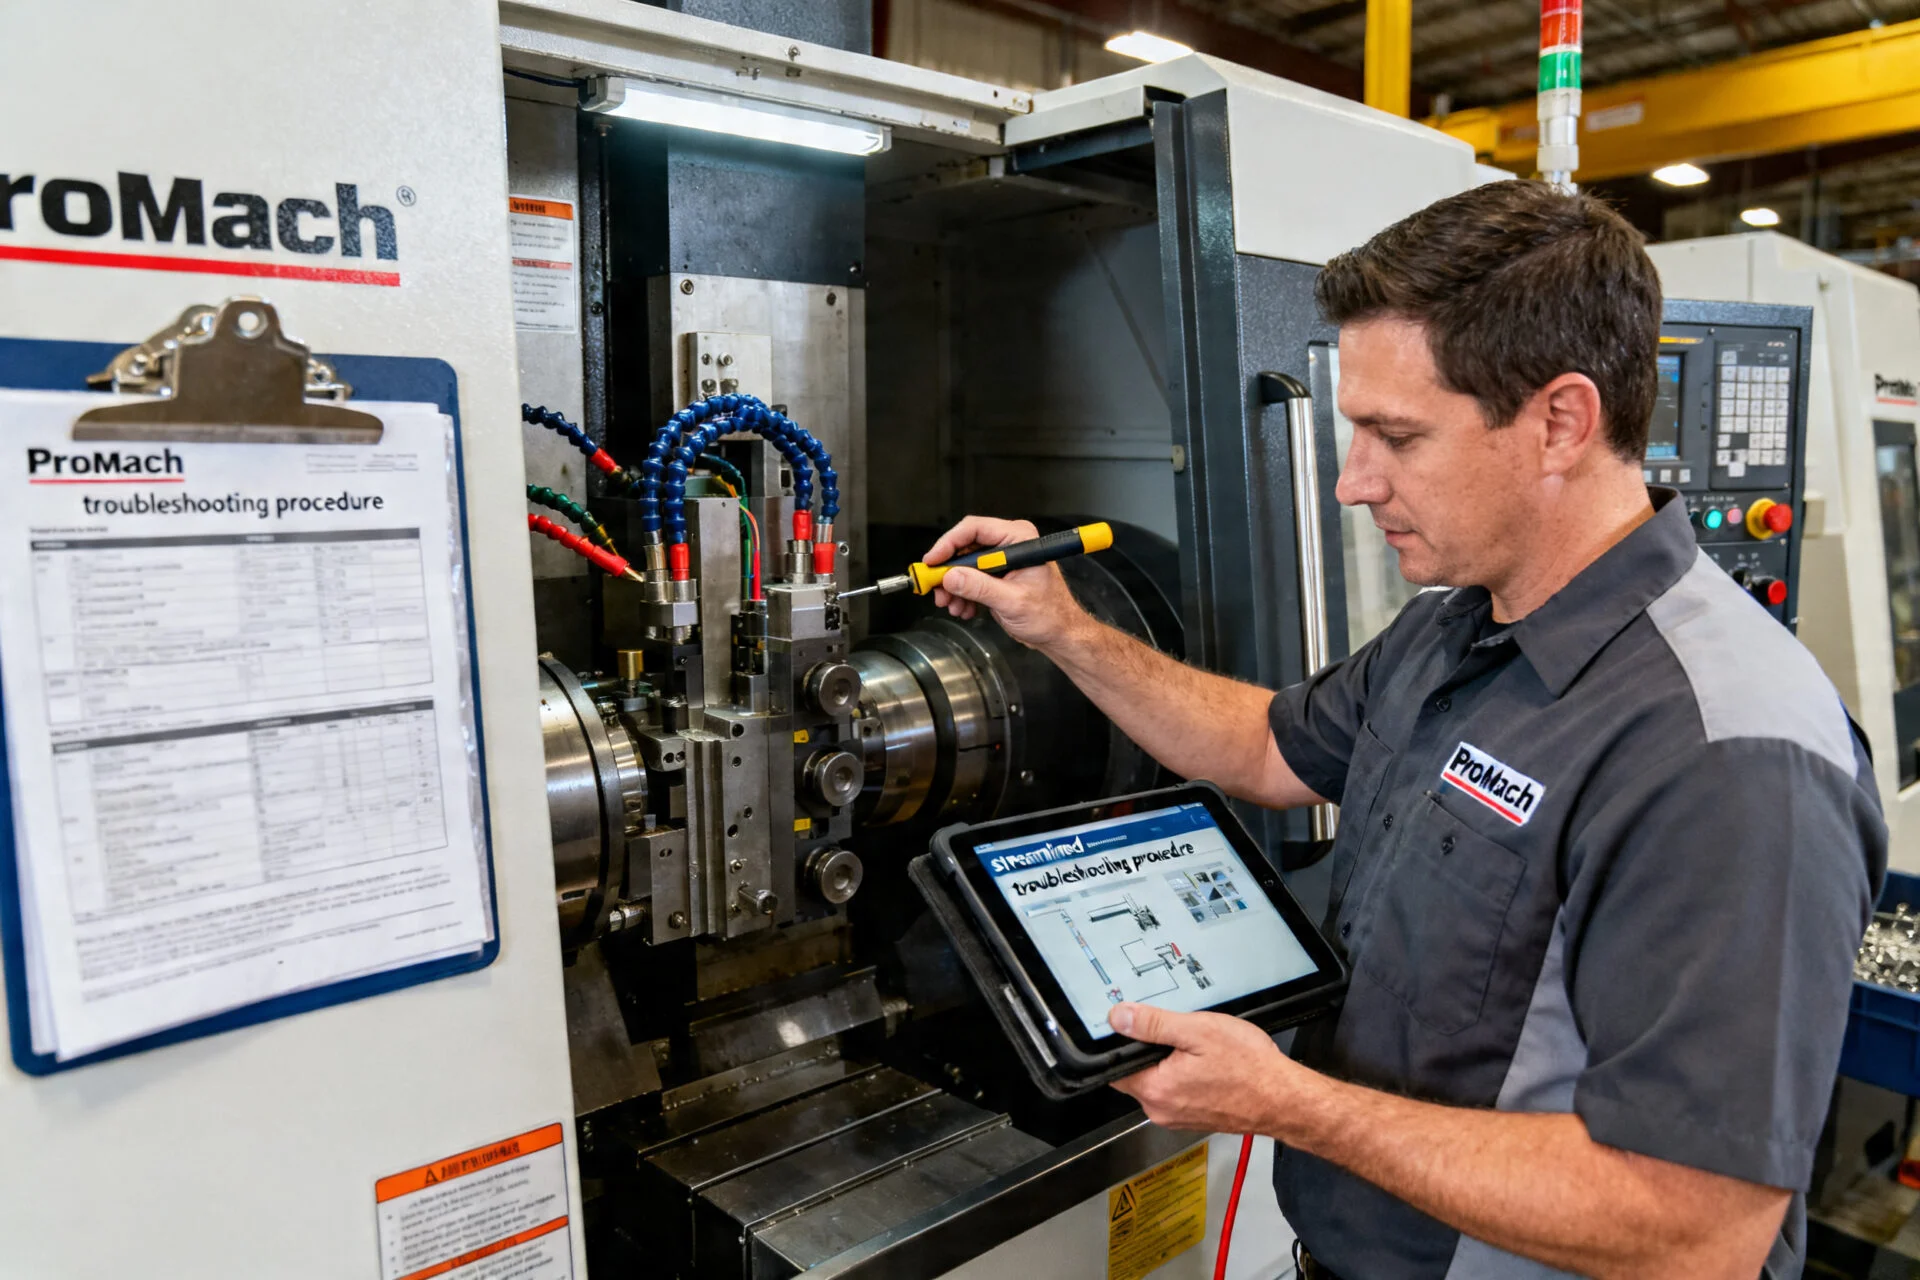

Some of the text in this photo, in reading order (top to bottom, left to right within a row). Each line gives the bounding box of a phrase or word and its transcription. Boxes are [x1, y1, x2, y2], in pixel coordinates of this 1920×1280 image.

[0, 171, 398, 261] roMach
[27, 447, 184, 474] ProMach
[83, 491, 384, 519] troubleshooting procedure
[1449, 746, 1535, 813] ProMach
